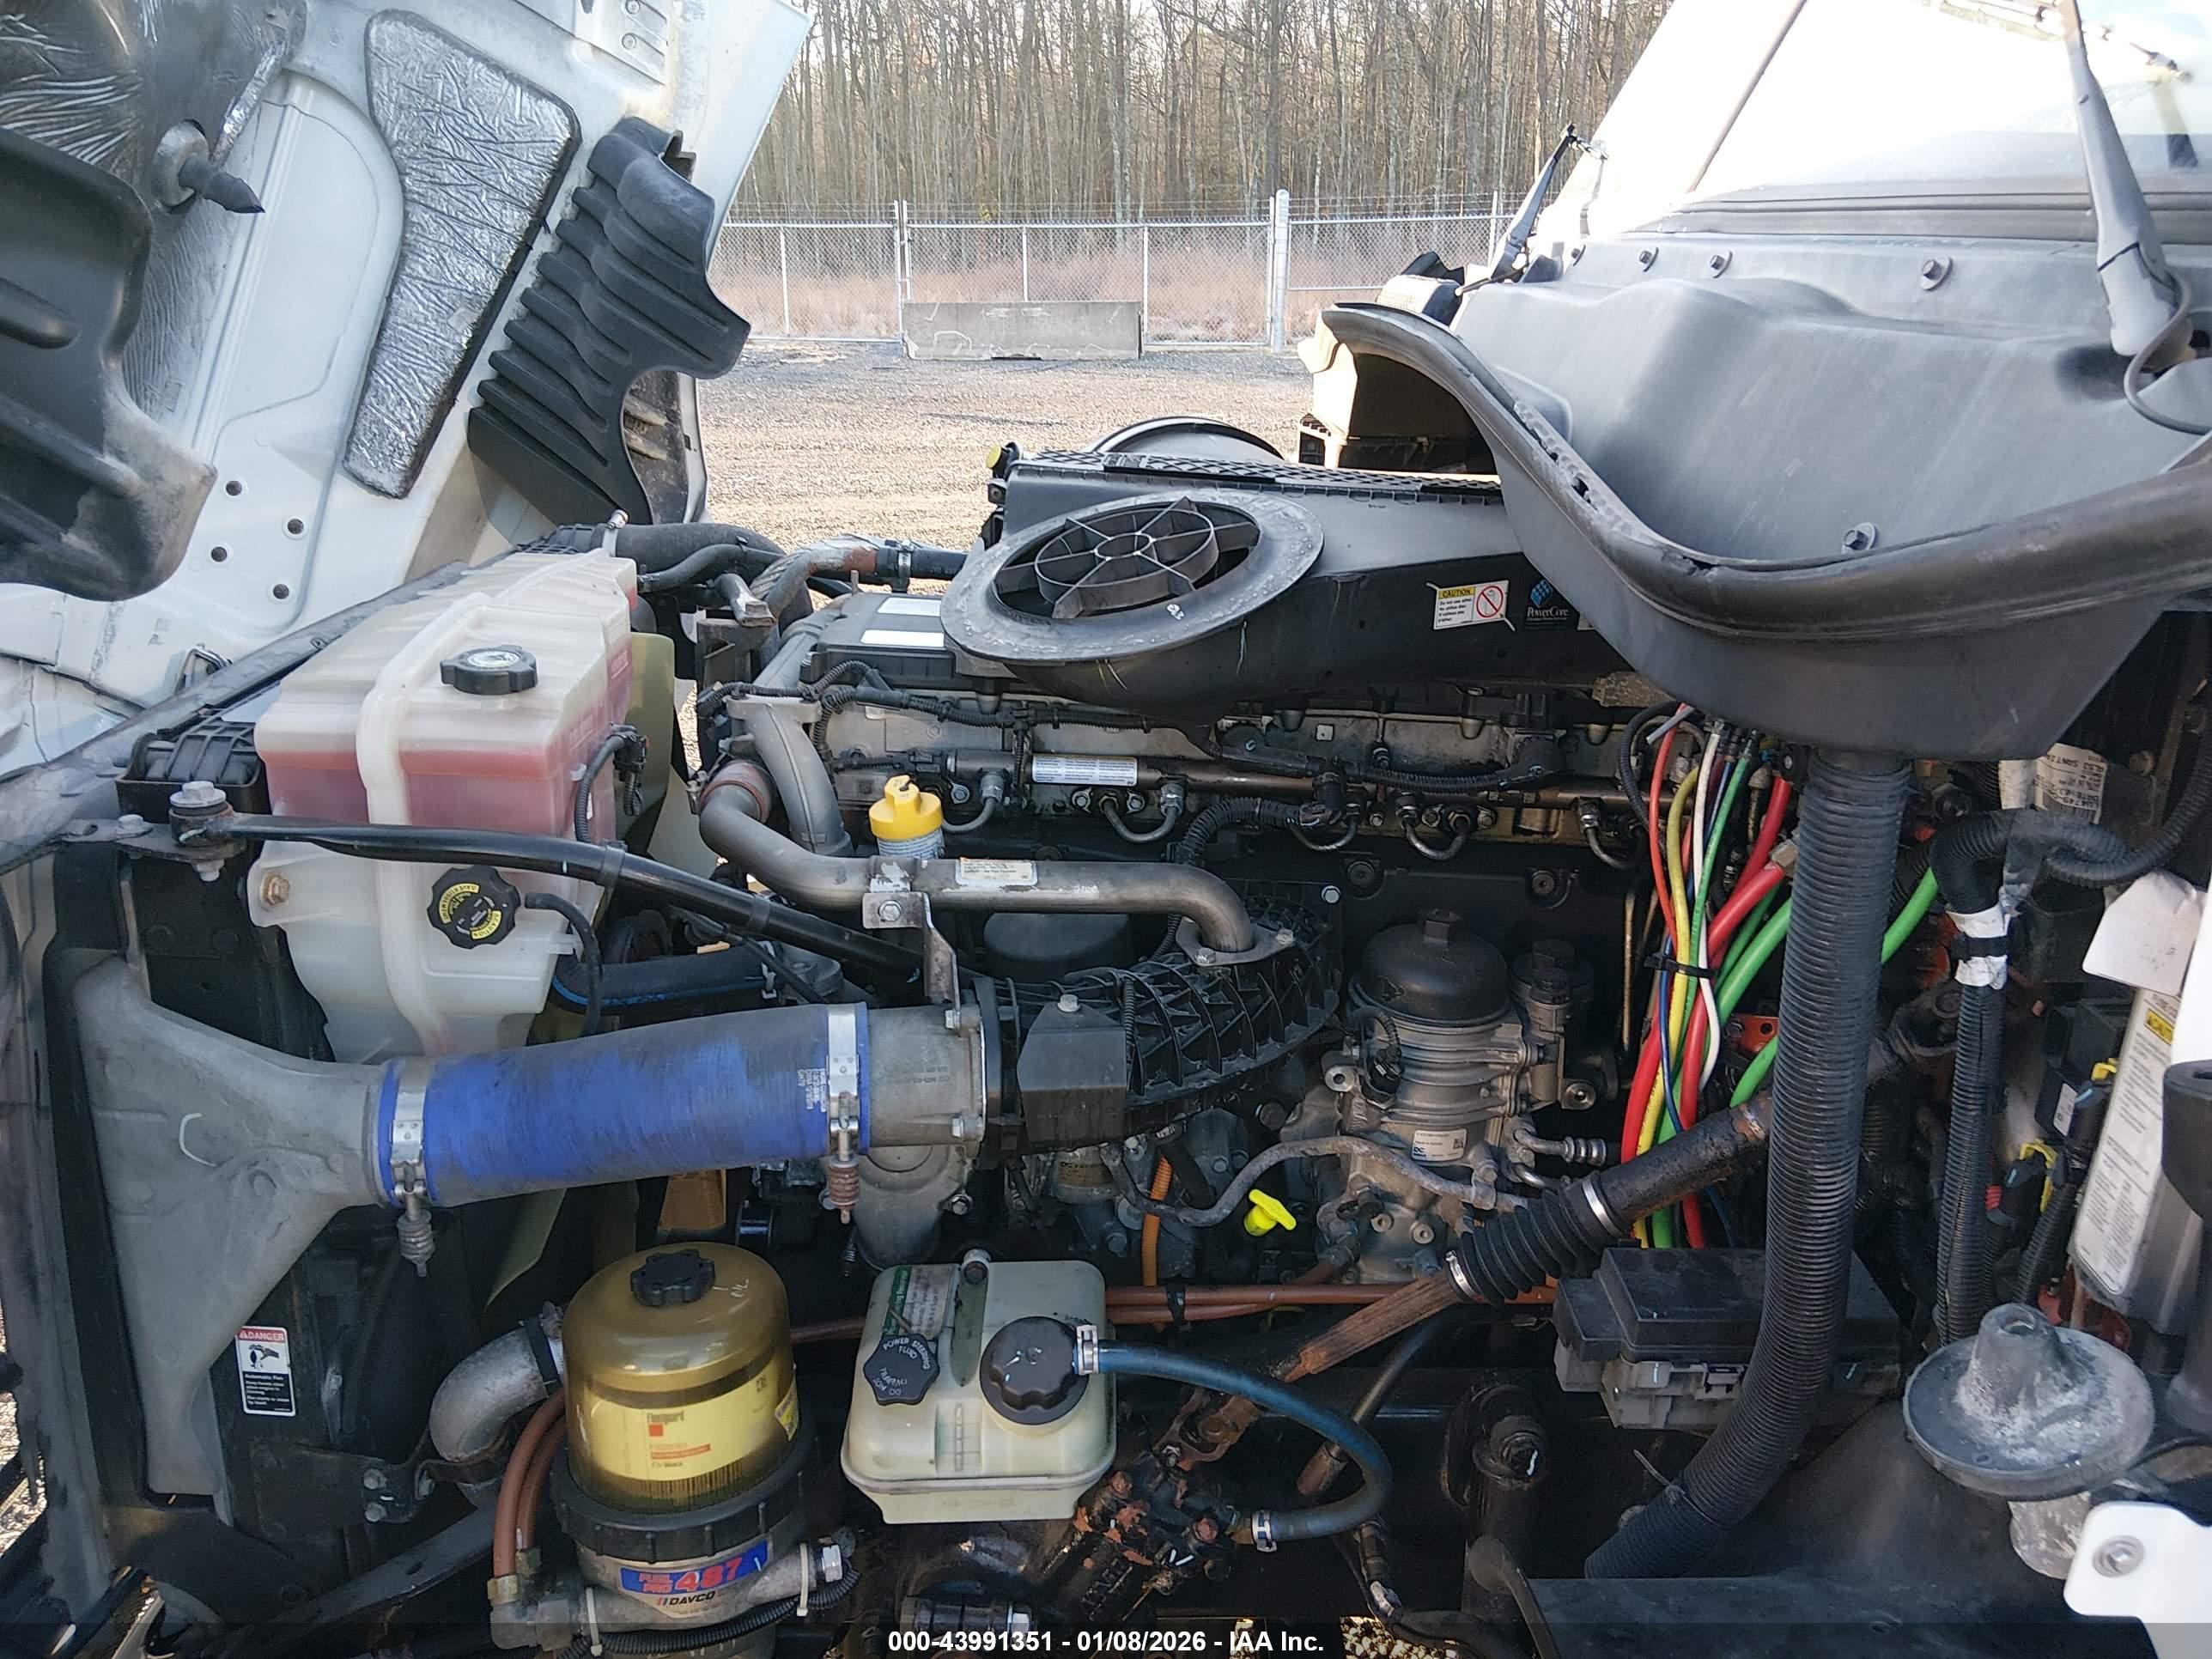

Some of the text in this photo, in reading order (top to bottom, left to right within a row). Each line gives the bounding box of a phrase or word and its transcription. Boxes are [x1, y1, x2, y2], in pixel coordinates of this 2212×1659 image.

[1442, 588, 1471, 599] CAUTION
[1527, 605, 1570, 618] PowerCore
[247, 1331, 284, 1341] DANGER
[883, 1337, 931, 1370] POWER STEERING
[898, 1346, 918, 1359] FLUID
[639, 1572, 673, 1584] FUEL
[674, 1556, 743, 1593] 487
[642, 1583, 673, 1594] PRO
[668, 1589, 717, 1607] DAVCO
